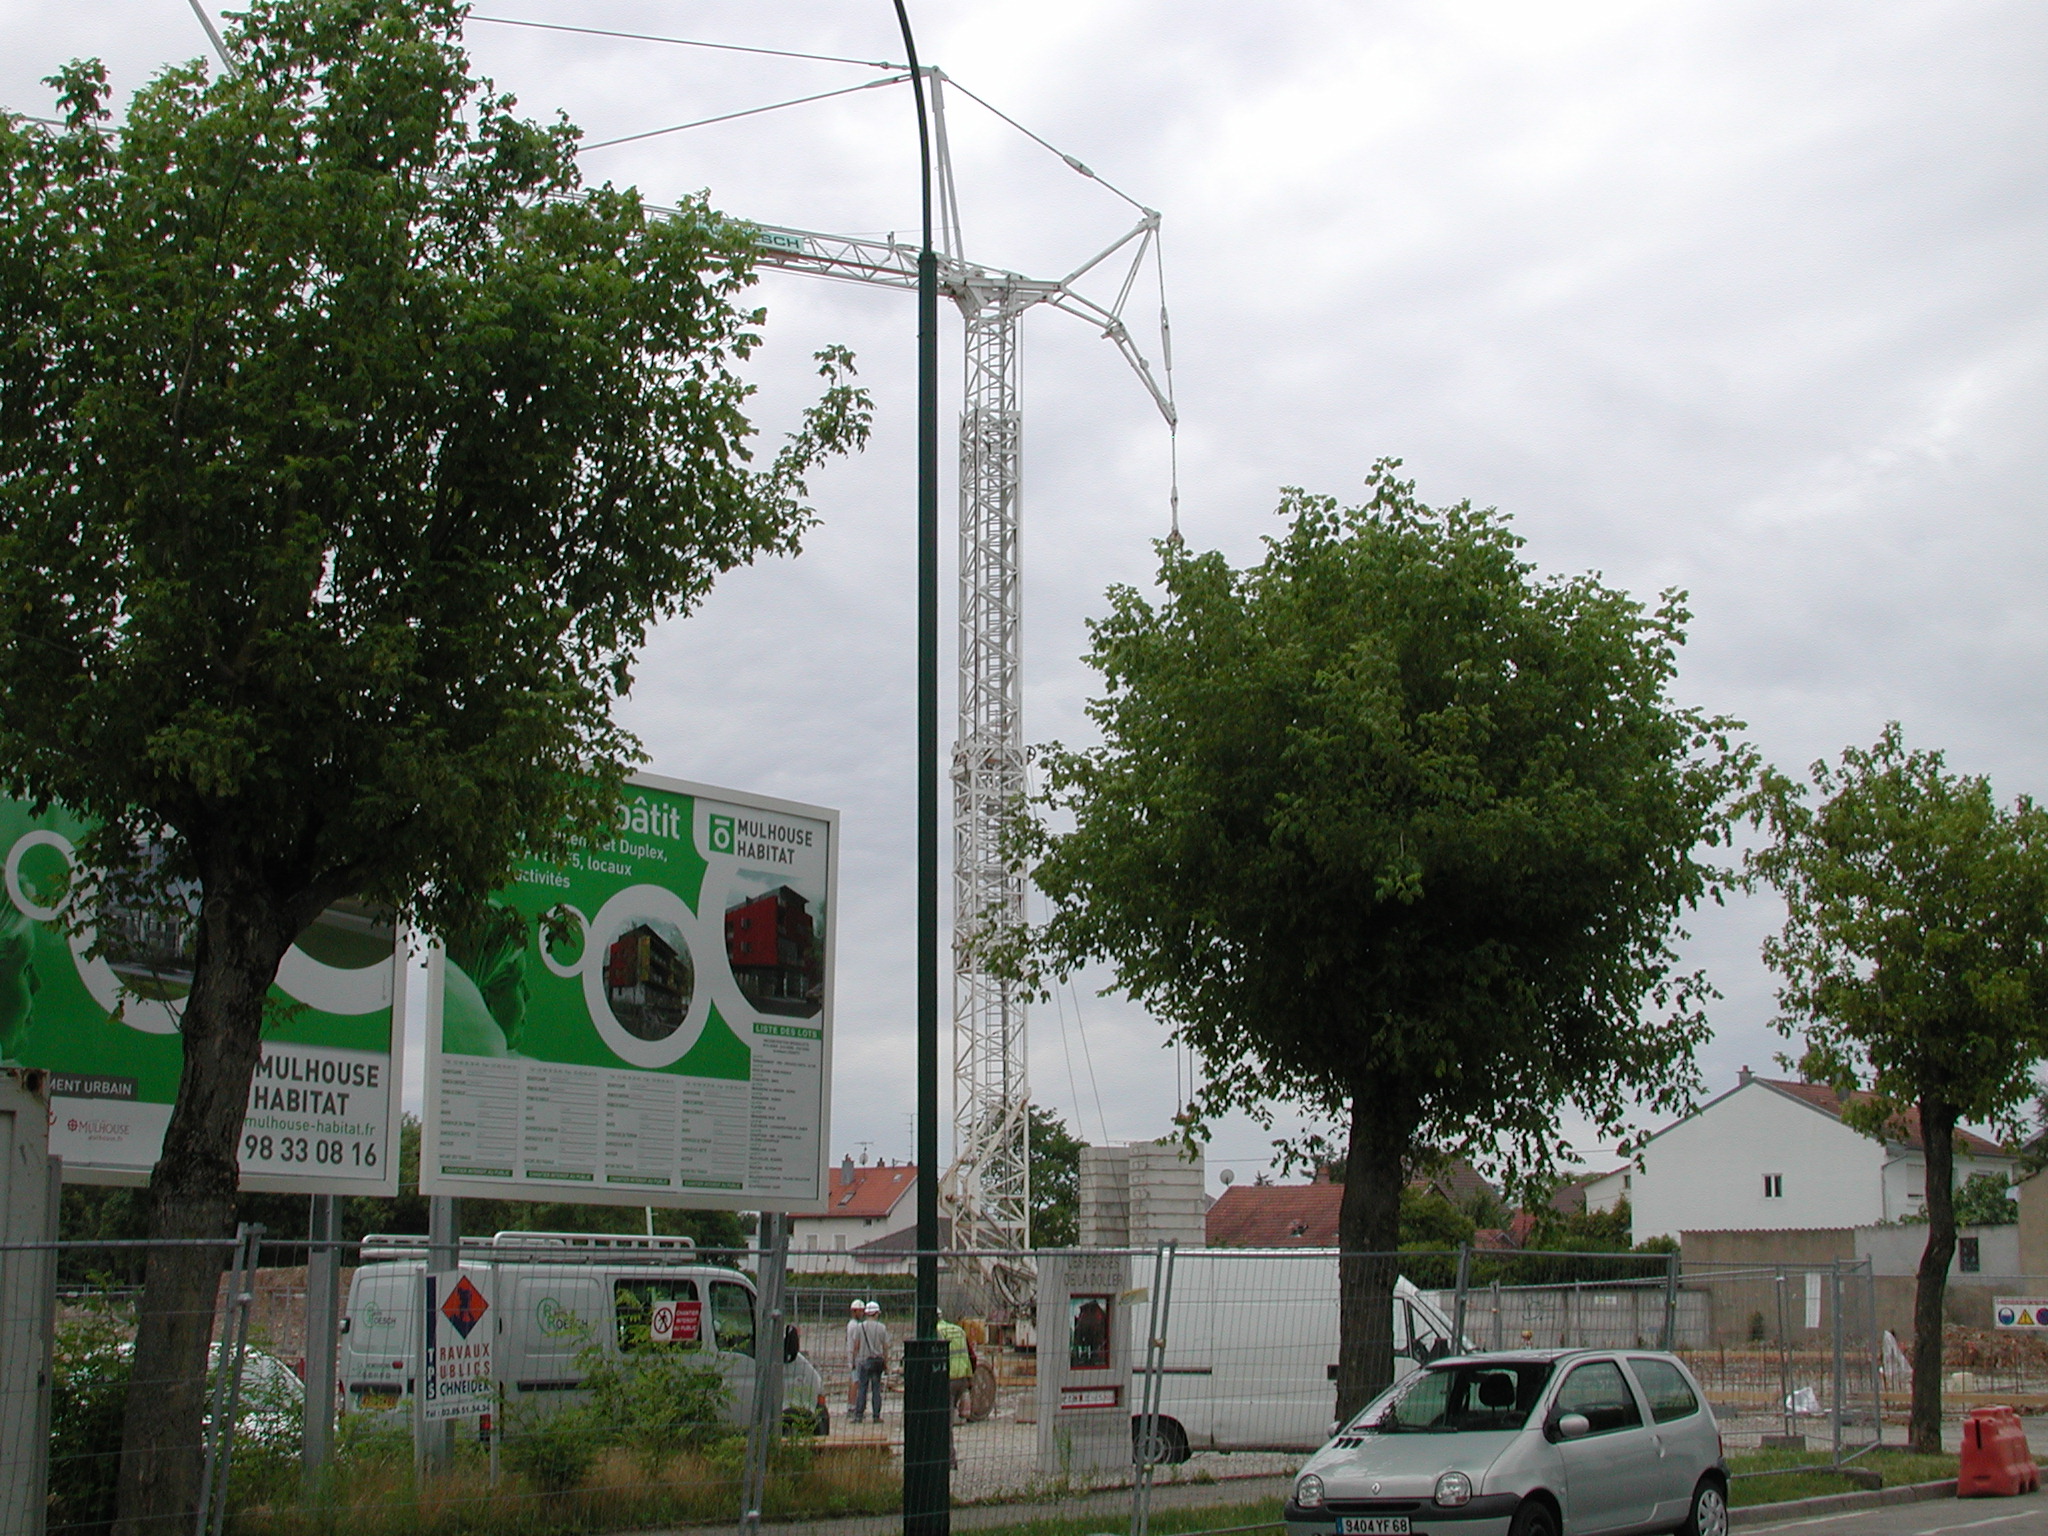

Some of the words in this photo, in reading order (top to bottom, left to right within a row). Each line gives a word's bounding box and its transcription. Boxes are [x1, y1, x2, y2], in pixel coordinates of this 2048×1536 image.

[738, 819, 813, 847] MULHOUSE
[619, 840, 668, 863] Duplex,
[737, 840, 795, 864] HABITAT
[587, 855, 632, 877] locaux
[755, 1024, 778, 1034] LISTE
[780, 1027, 796, 1036] DES
[797, 1029, 818, 1039] LOTS
[255, 1055, 379, 1088] MULHOUSE
[84, 1080, 132, 1095] URBAIN
[254, 1086, 350, 1116] HABITAT
[79, 1121, 131, 1135] MULHOUSE
[245, 1134, 273, 1160] 98
[280, 1137, 308, 1162] 33
[316, 1139, 343, 1164] 08
[352, 1142, 377, 1167] 16
[1345, 1518, 1374, 1533] 9404
[1375, 1518, 1390, 1533] YF
[1392, 1518, 1408, 1533] 68
